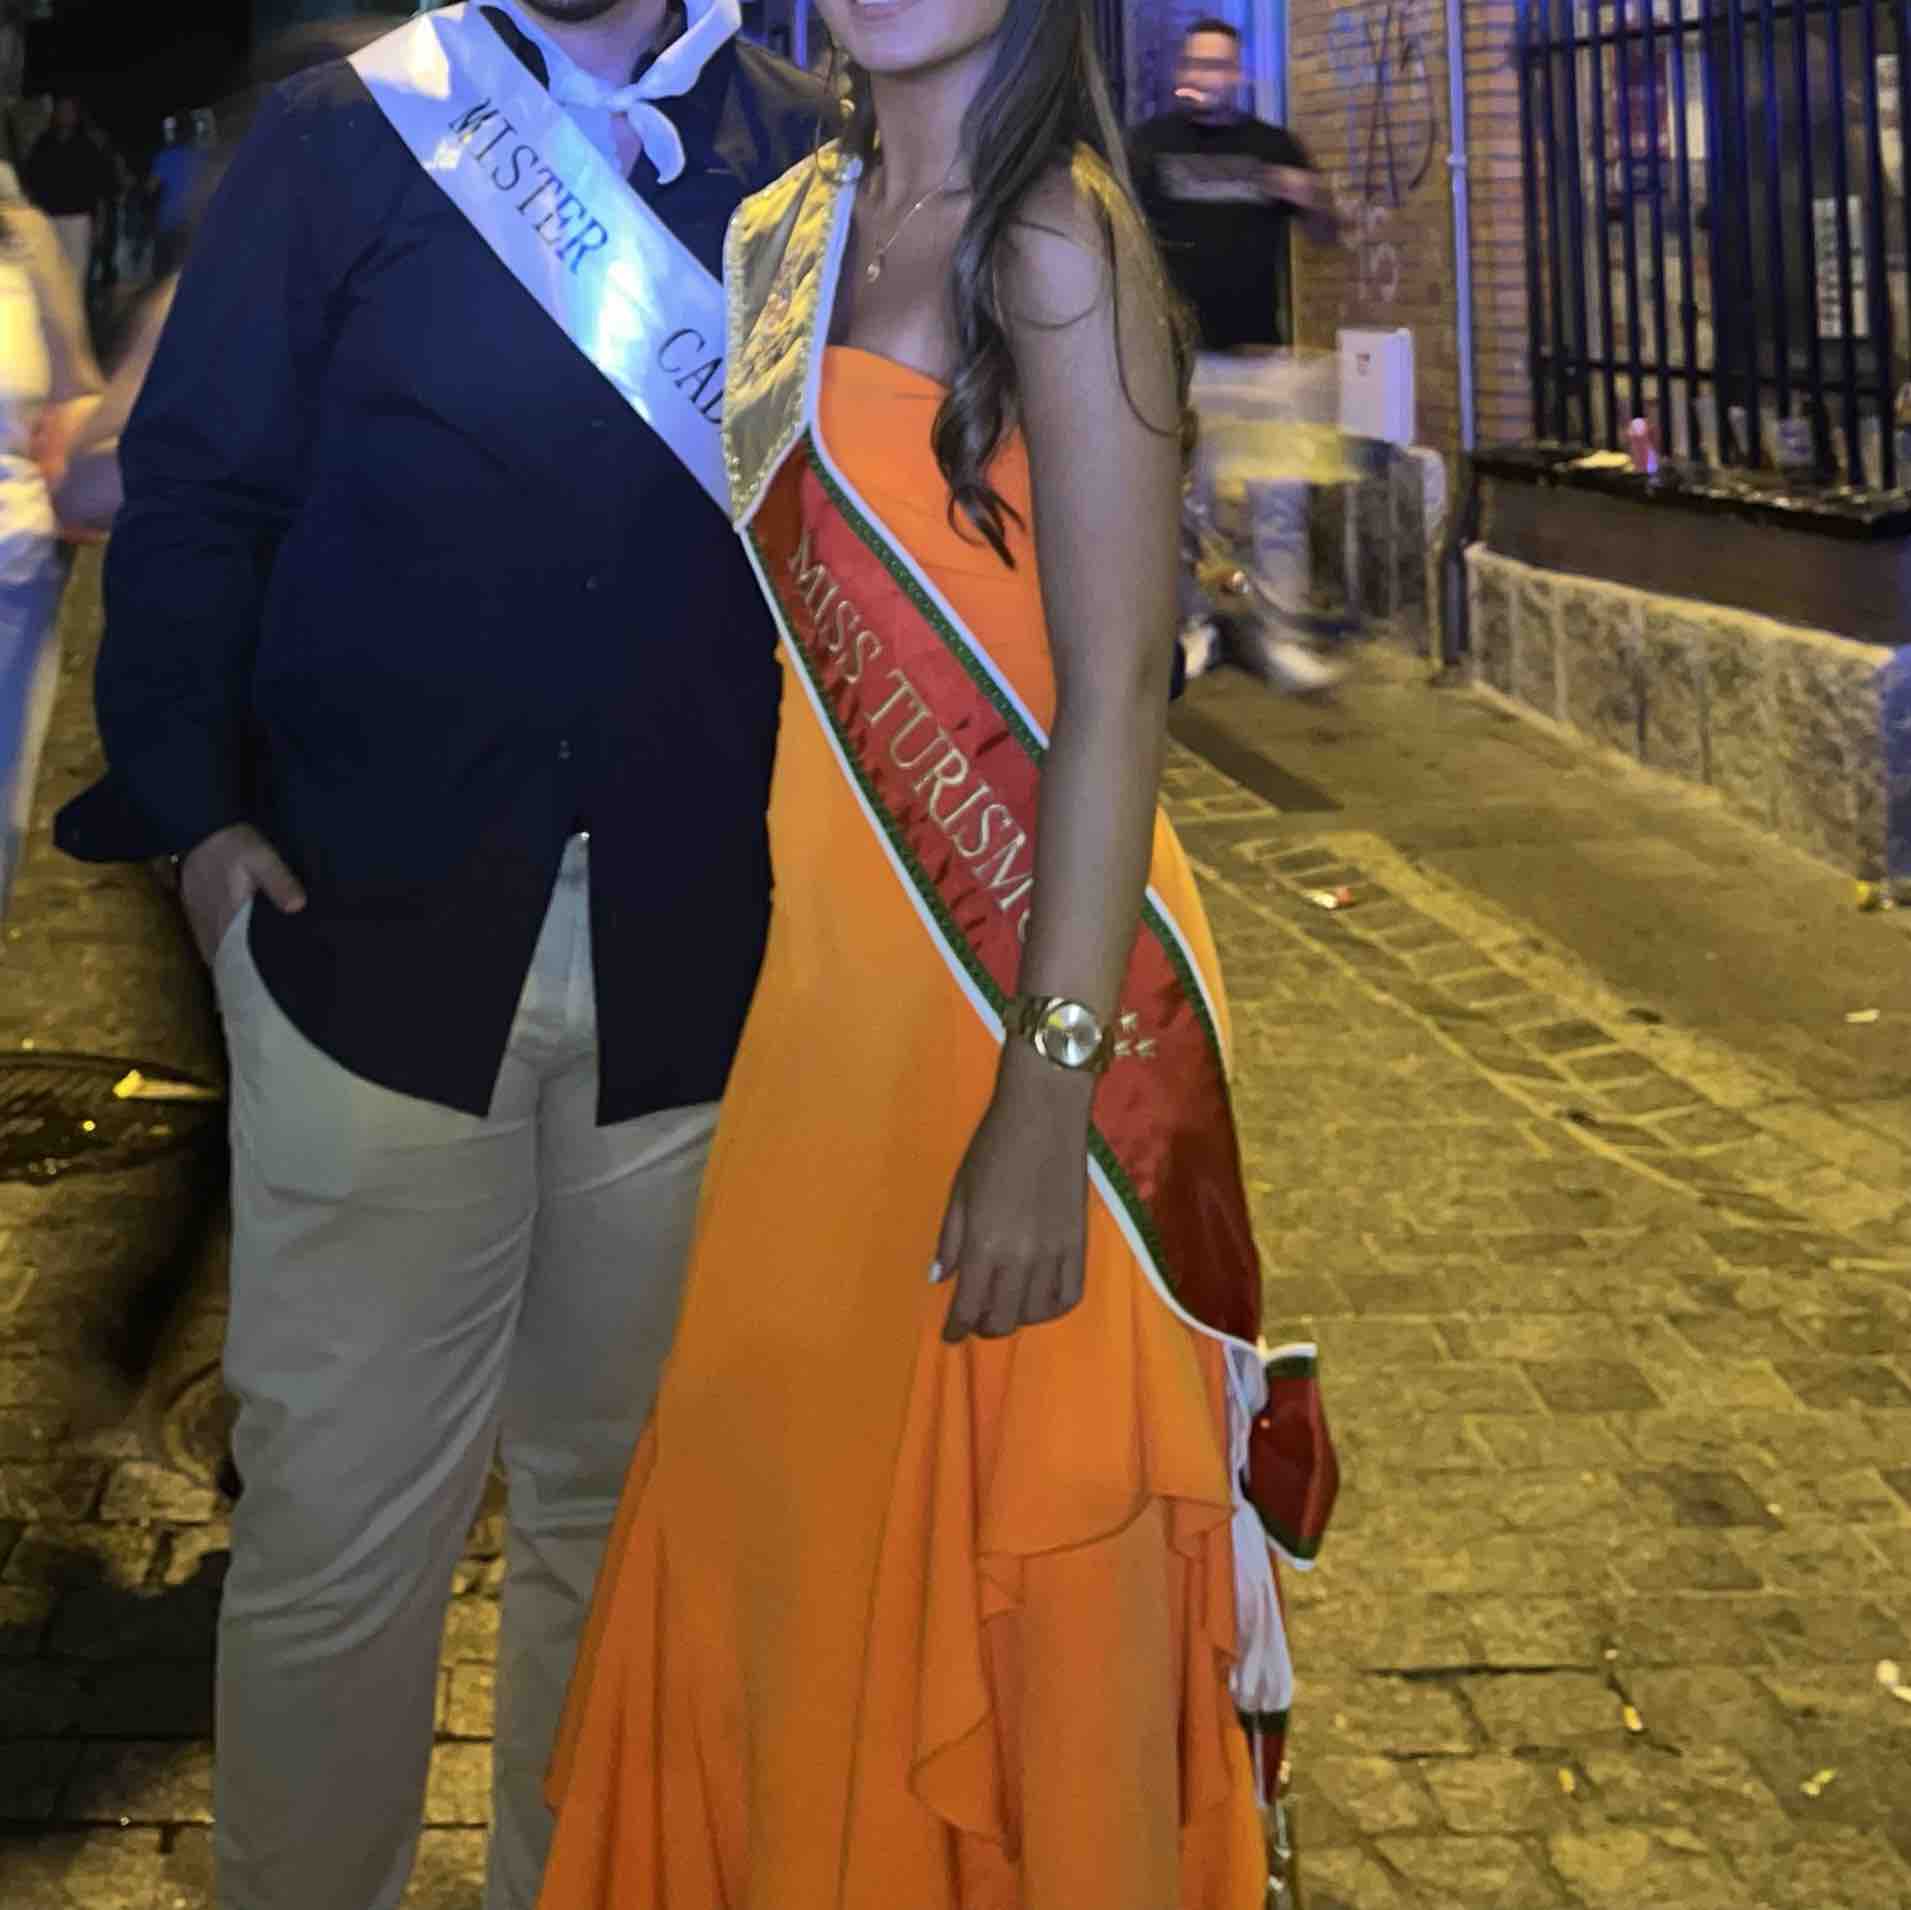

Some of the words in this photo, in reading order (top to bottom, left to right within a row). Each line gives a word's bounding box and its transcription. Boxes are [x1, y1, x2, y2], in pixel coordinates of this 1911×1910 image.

[448, 98, 608, 274] MISTER
[788, 530, 883, 684] MISS
[864, 668, 1034, 943] TURISM
